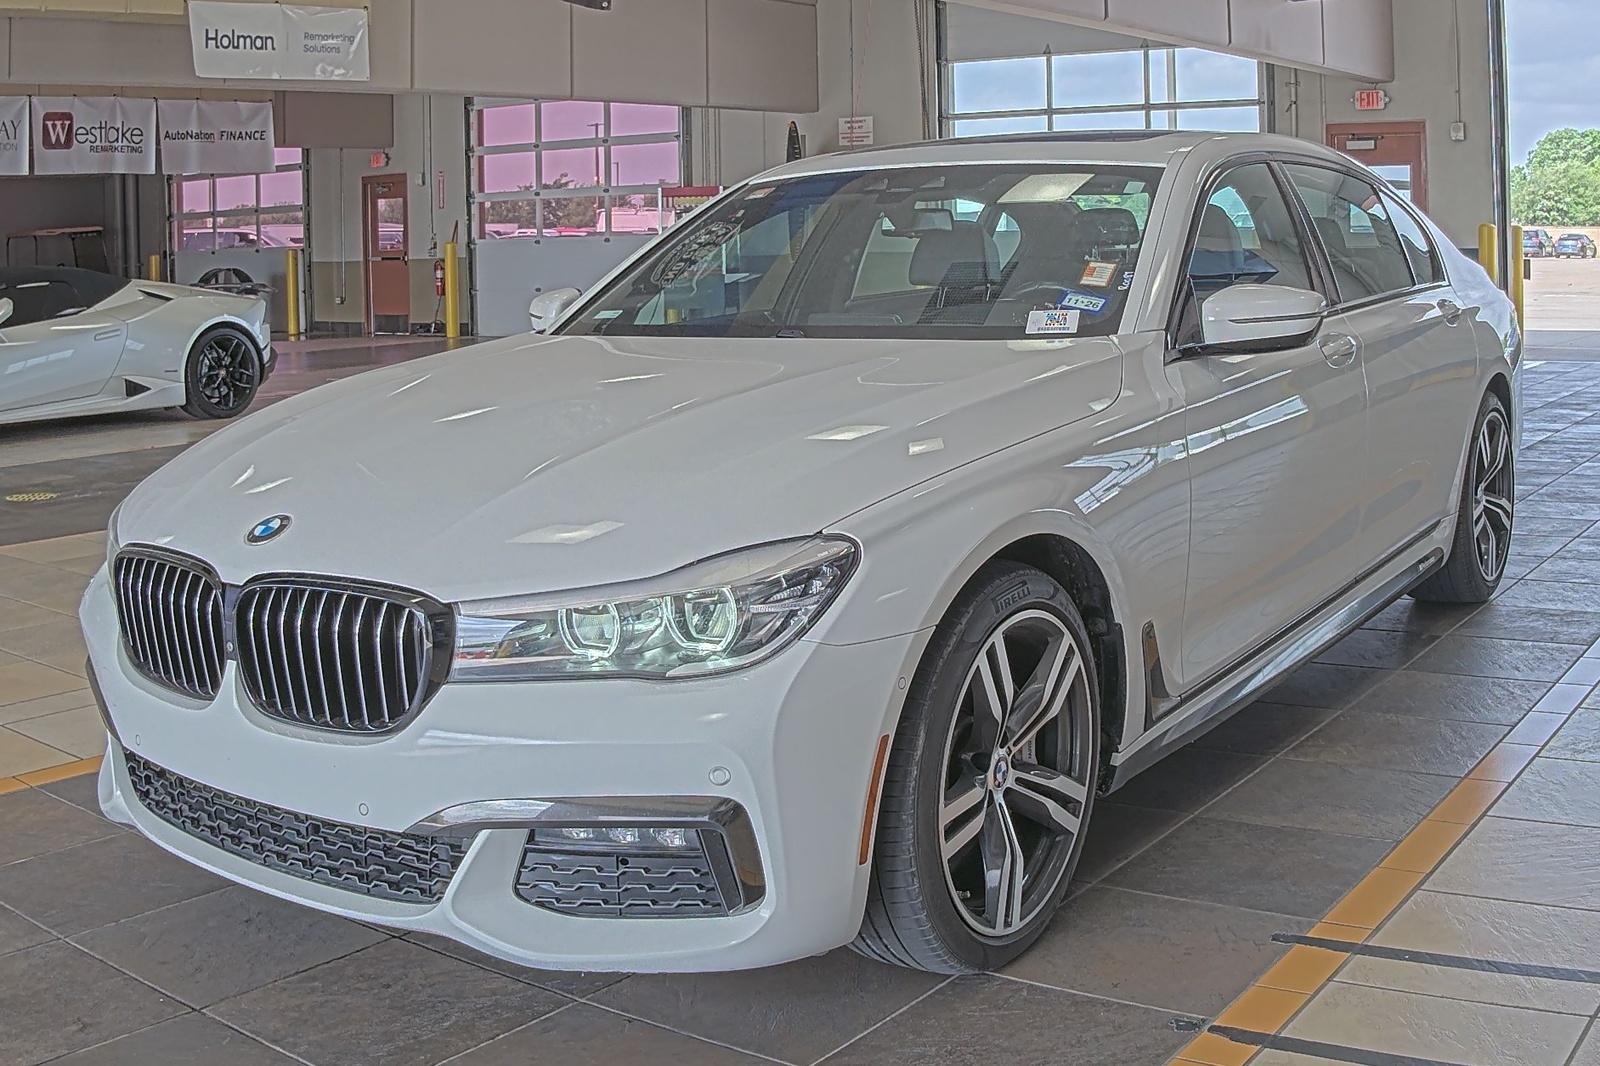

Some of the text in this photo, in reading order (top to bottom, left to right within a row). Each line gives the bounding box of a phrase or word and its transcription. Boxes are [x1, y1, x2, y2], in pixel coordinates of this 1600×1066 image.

[205, 29, 276, 50] Holman
[303, 32, 355, 45] Remarketing
[303, 44, 341, 54] Solutions
[1359, 91, 1380, 108] EXIT
[45, 120, 144, 145] Westlake
[163, 130, 267, 143] AutoNation FINANCE
[89, 144, 143, 154] REMARKETING
[991, 580, 1031, 615] PIRELLI
